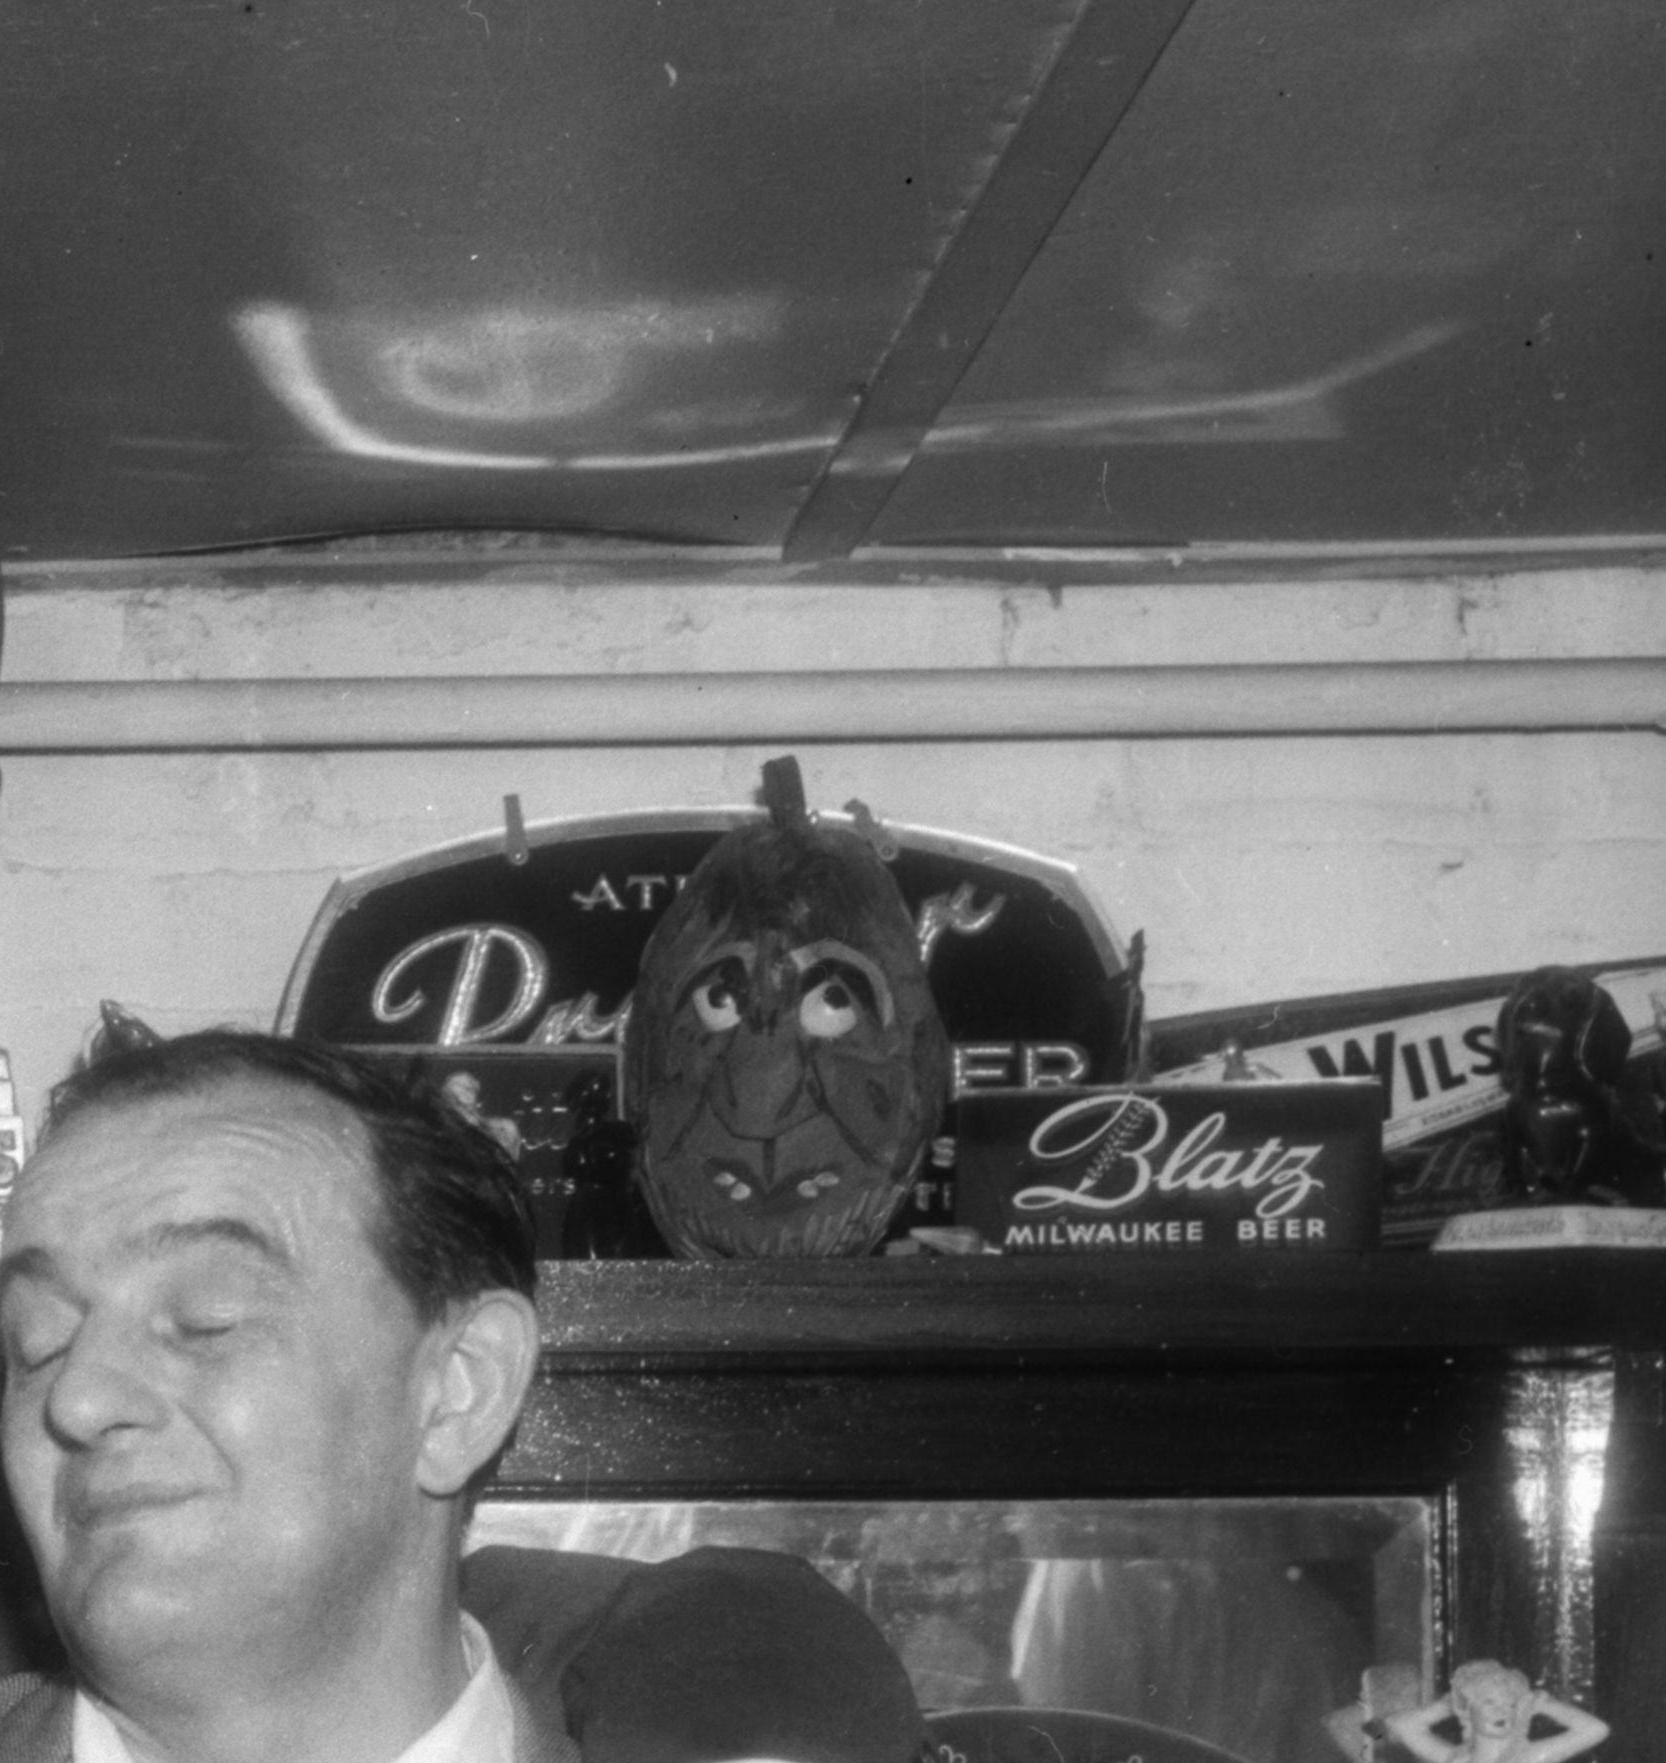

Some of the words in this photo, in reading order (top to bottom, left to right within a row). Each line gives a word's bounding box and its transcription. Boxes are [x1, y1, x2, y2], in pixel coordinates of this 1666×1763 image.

[1305, 1023, 1504, 1122] WILS
[1010, 1094, 1326, 1220] Blatz
[1004, 1220, 1205, 1245] MILWAUKEE
[1236, 1217, 1328, 1242] BEER
